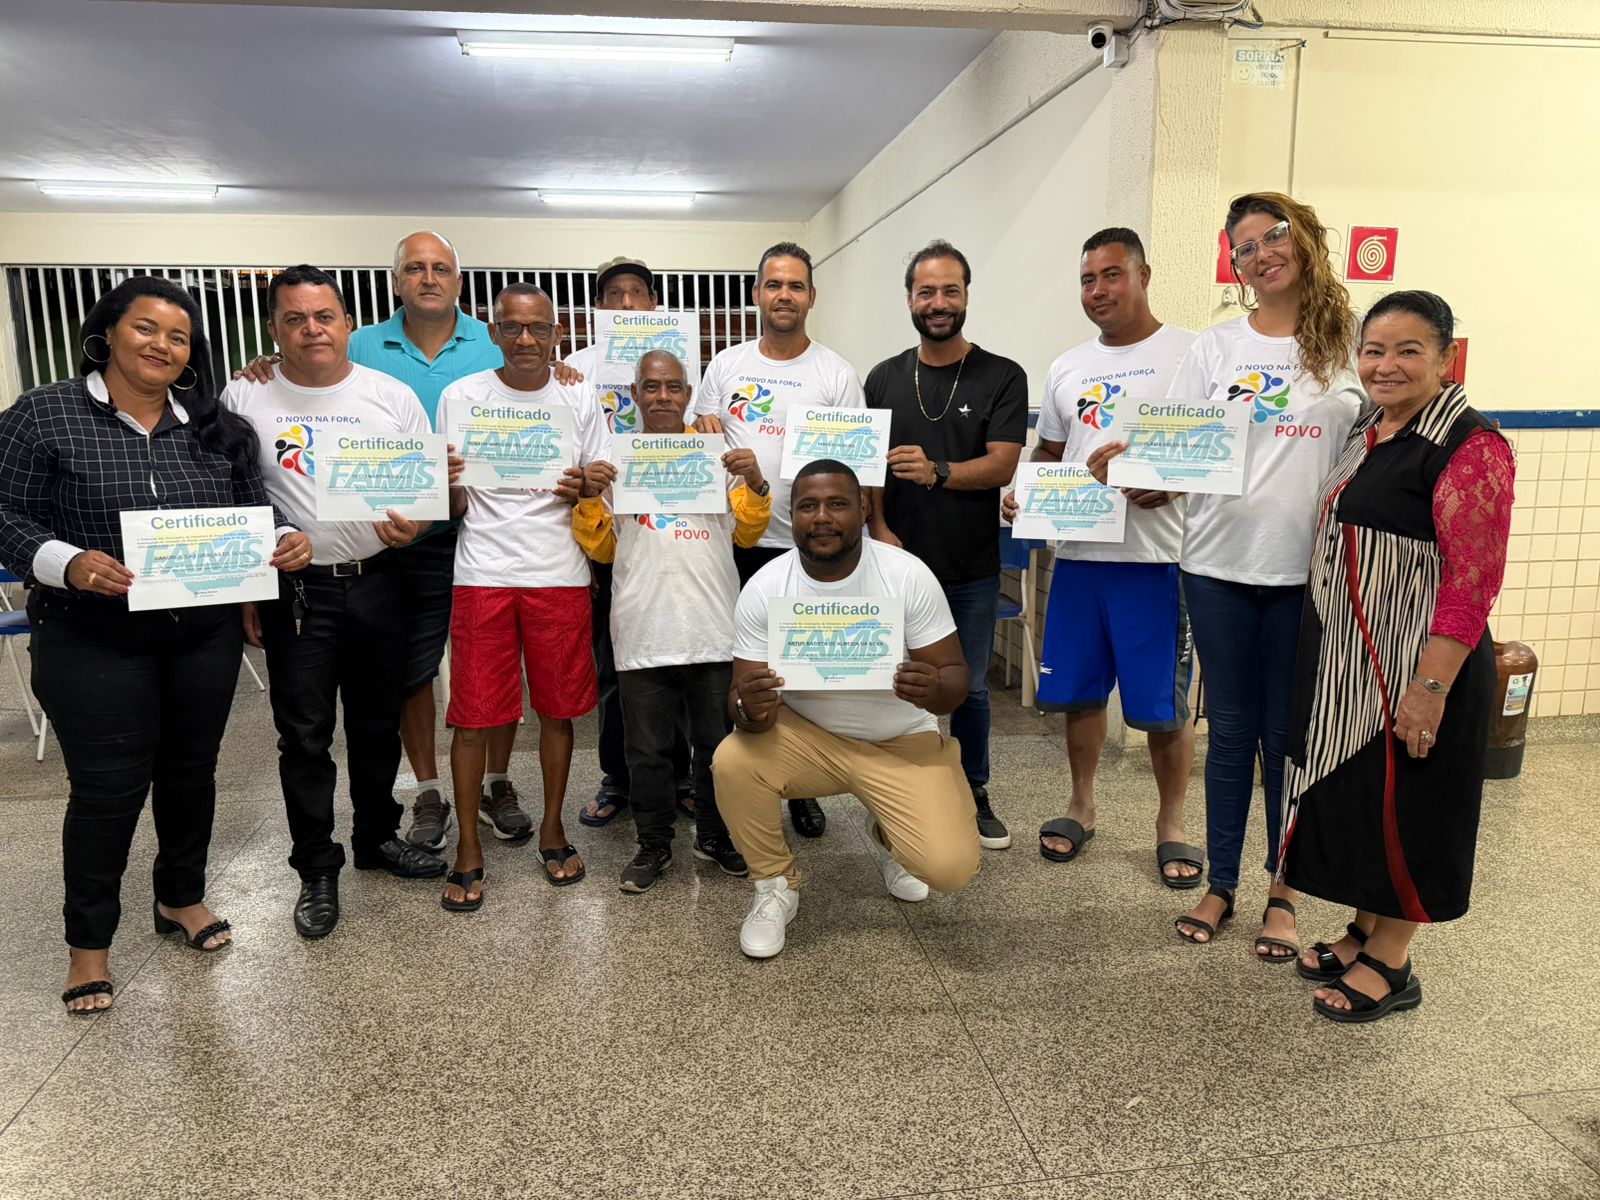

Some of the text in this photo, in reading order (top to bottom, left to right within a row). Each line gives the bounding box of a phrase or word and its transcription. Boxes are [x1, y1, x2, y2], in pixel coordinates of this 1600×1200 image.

[613, 314, 678, 326] Certificado
[607, 336, 688, 360] FAMS
[1090, 375, 1113, 383] NOVO
[471, 406, 551, 421] Certificado
[806, 410, 872, 424] Certificado
[1138, 403, 1225, 418] Certificado
[759, 425, 785, 436] POV
[1275, 425, 1322, 438] POVO
[338, 437, 424, 450] Certificado
[462, 430, 562, 459] FAMS
[631, 438, 704, 449] Certificado
[794, 432, 880, 458] FAMS
[1126, 430, 1235, 461] FAMS
[329, 461, 436, 489] FAMS
[625, 461, 715, 488] FAMS
[1037, 467, 1092, 478] Certifica
[1026, 488, 1117, 514] FAMS
[151, 513, 248, 530] Certificado
[675, 530, 710, 540] POVO
[143, 539, 263, 577] FAMS
[793, 602, 879, 615] Certificado
[782, 630, 892, 660] FAMS
